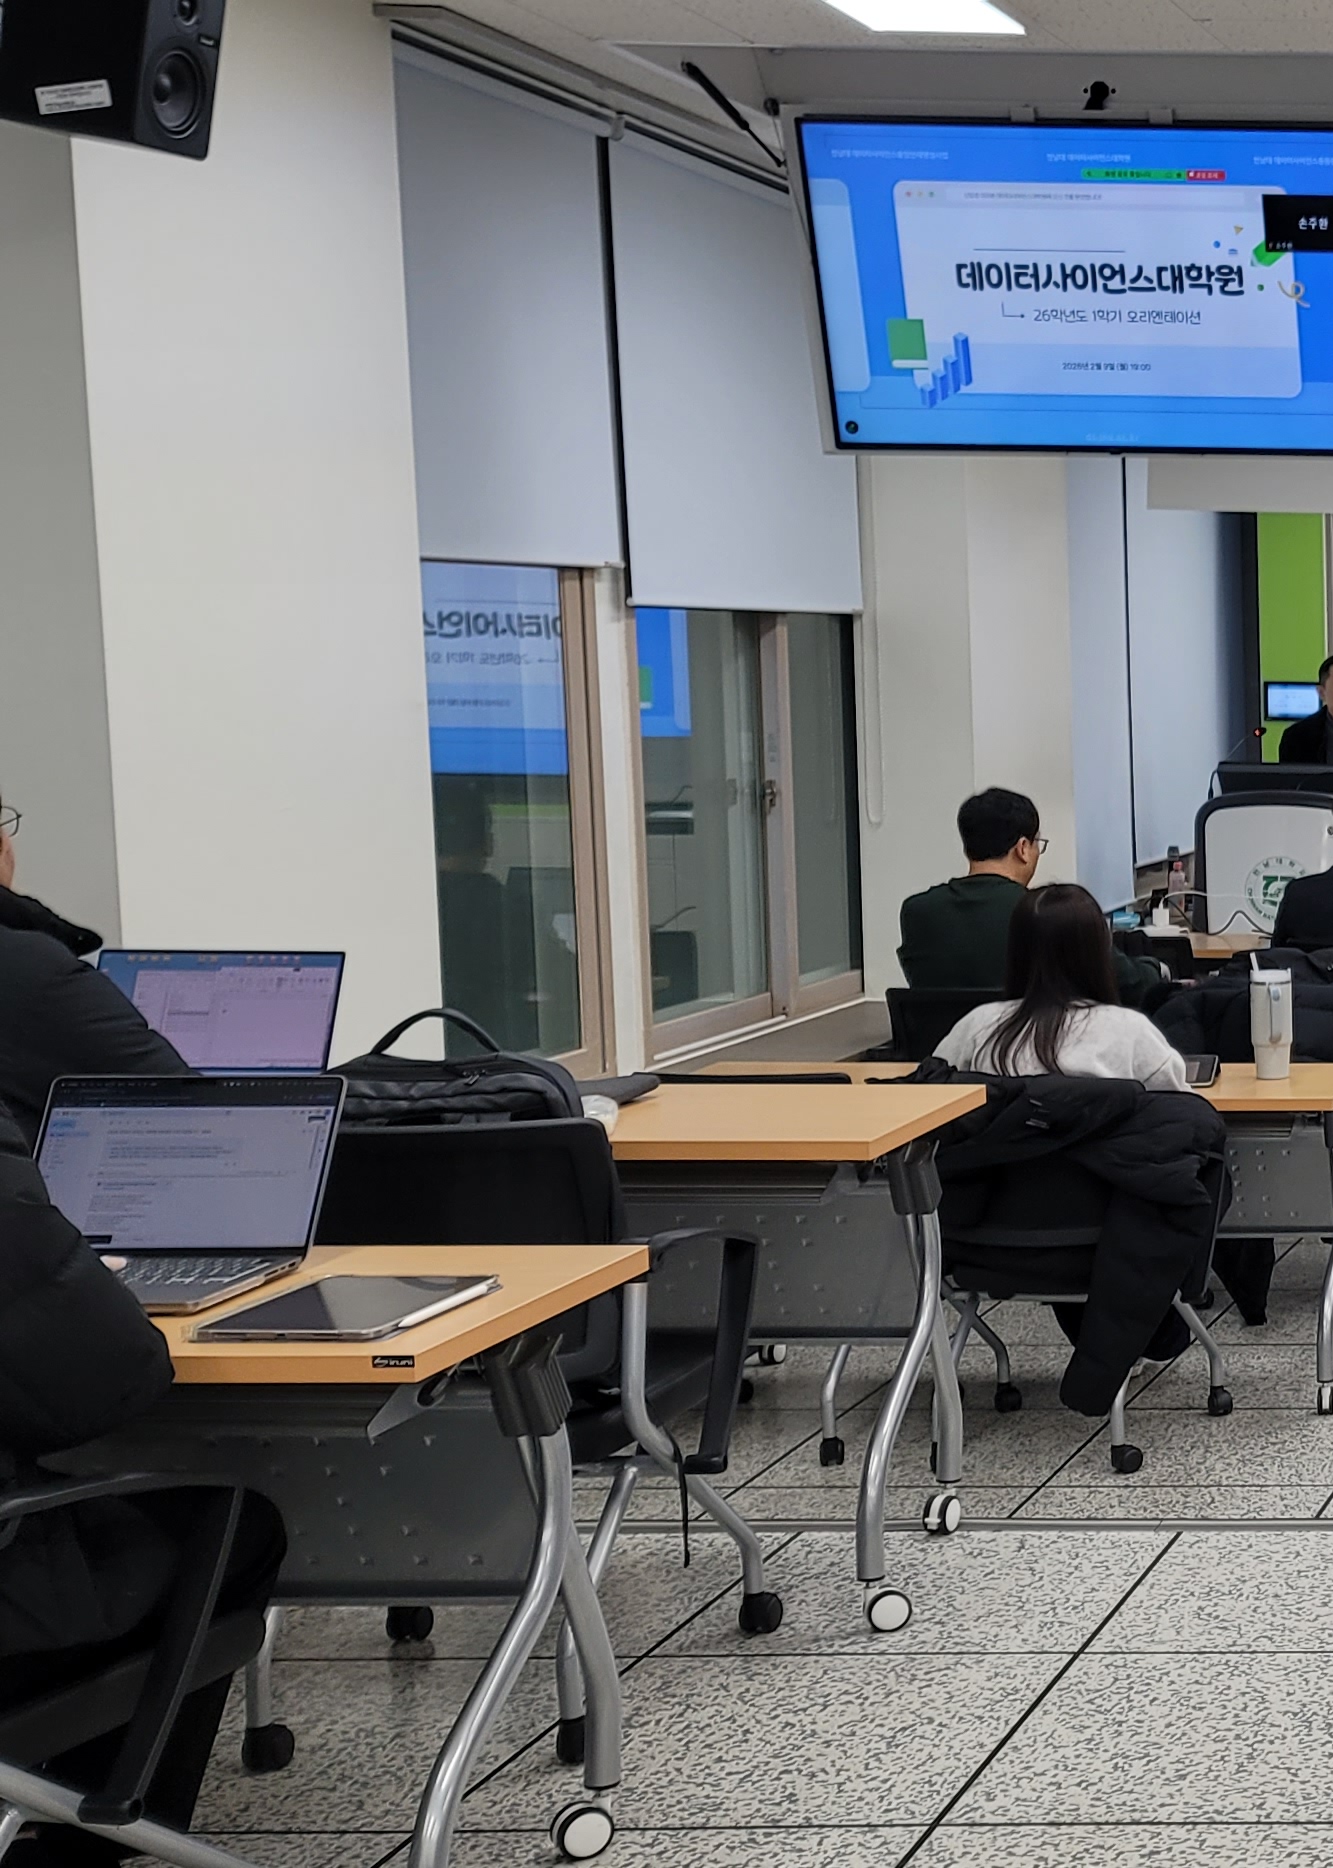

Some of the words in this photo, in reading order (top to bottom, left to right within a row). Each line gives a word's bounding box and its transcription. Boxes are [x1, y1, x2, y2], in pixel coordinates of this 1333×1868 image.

[955, 260, 1246, 297] 데이터사이언스대학원
[1033, 308, 1088, 326] 26학년도
[1091, 308, 1123, 326] 1학기
[1126, 308, 1202, 327] 오리엔테이션
